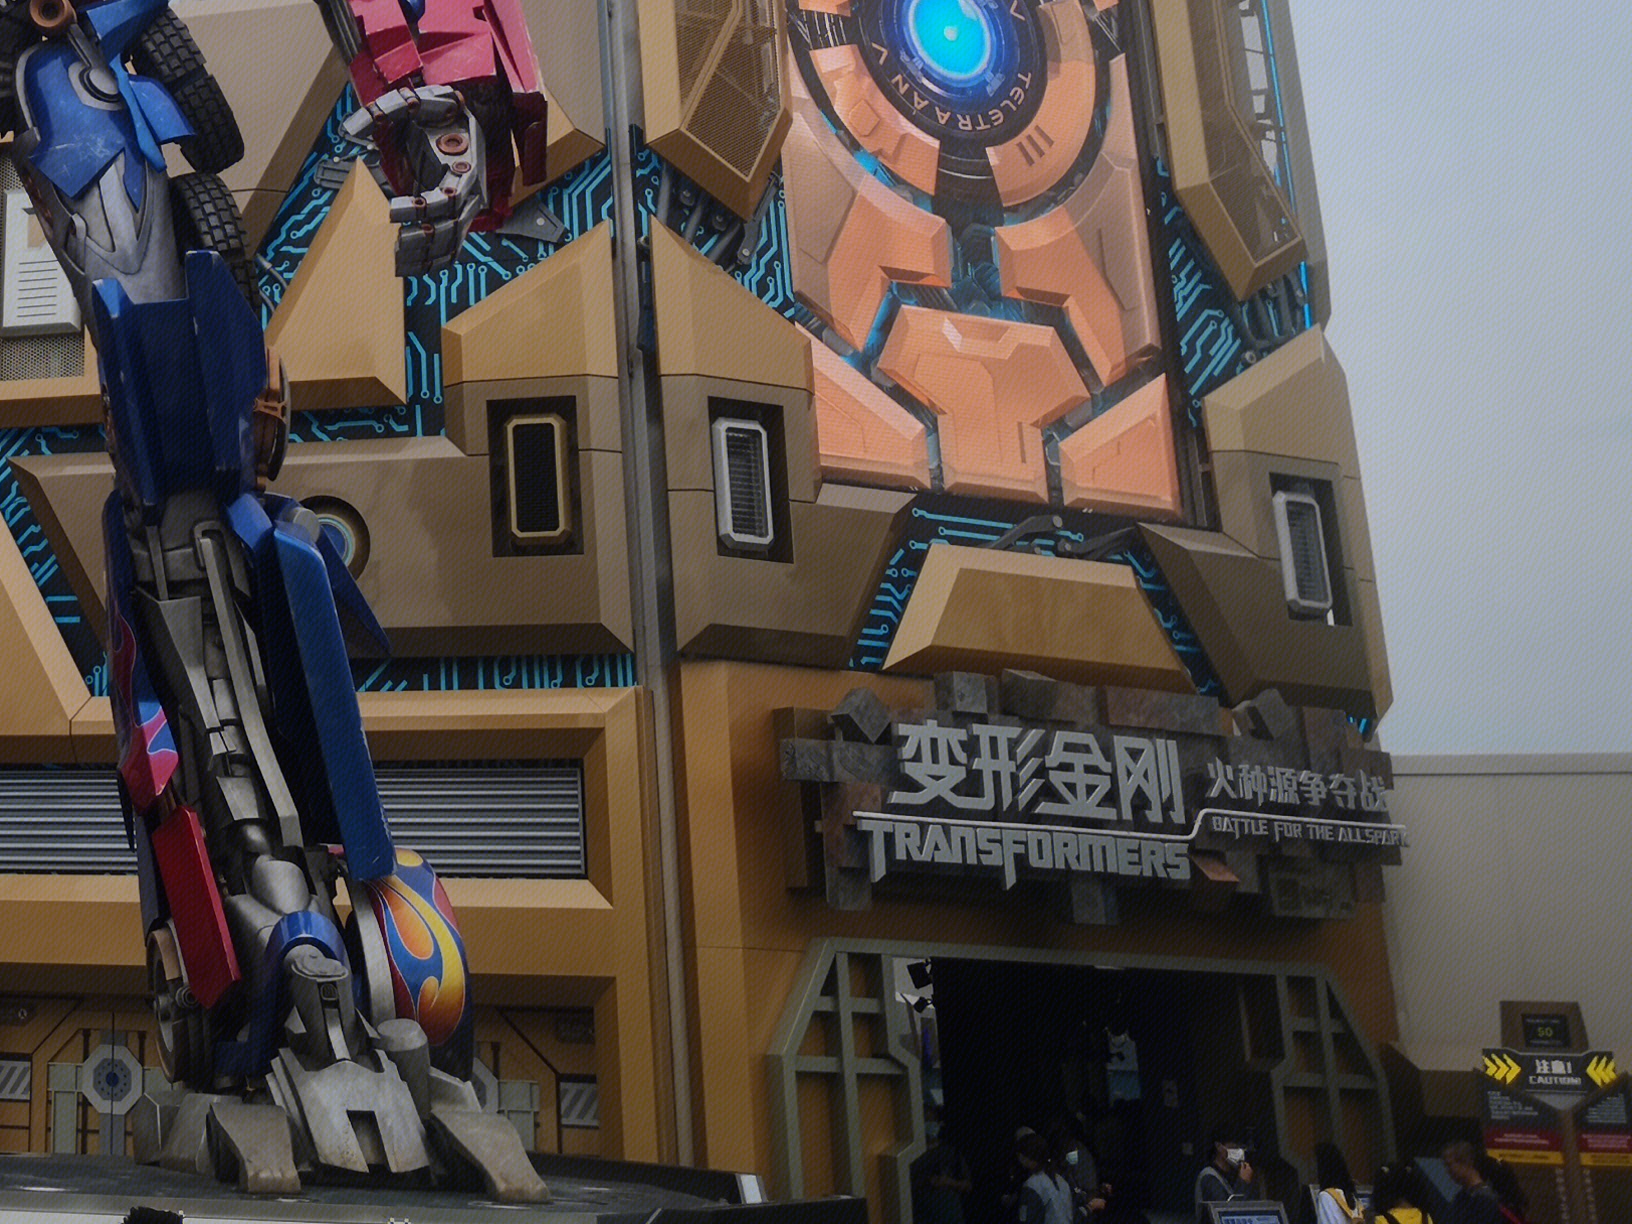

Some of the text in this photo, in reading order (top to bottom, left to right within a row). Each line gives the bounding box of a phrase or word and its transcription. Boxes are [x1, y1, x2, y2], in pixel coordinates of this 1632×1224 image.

[890, 72, 1032, 132] TELETRAAN
[887, 719, 1186, 825] 变形金刚
[1205, 756, 1392, 813] 火种源争夺战
[856, 819, 1192, 890] TRANSFORMERS
[1212, 816, 1410, 848] BATTLE FOR THE ALLSPARK
